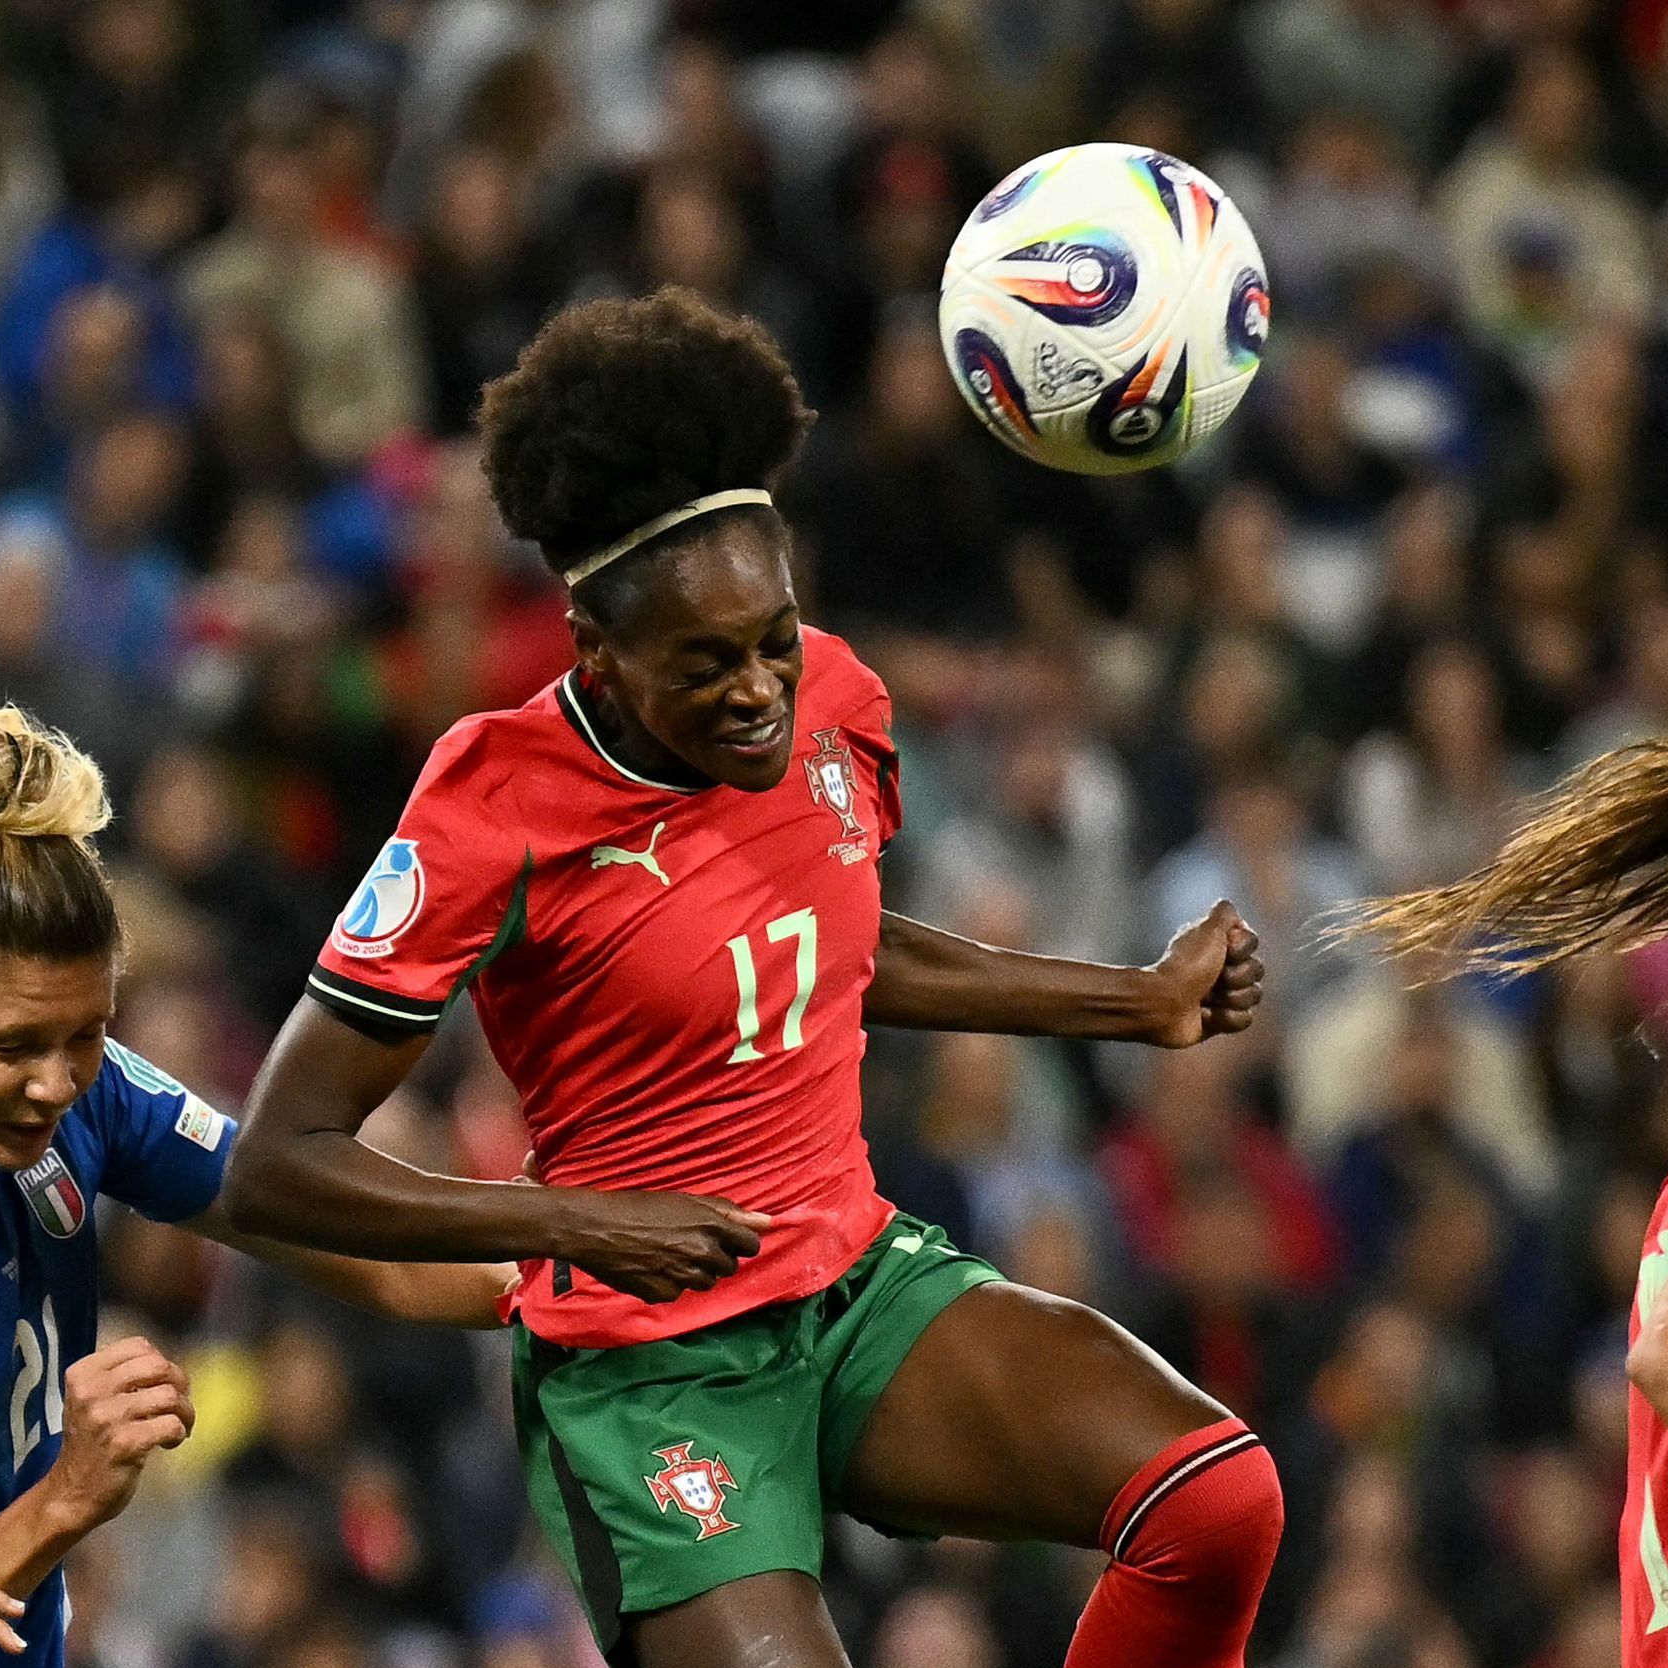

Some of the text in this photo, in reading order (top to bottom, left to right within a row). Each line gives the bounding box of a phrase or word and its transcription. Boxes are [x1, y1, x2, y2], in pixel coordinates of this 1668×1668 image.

[362, 942, 388, 954] 2025
[725, 905, 818, 1065] 17
[19, 1155, 61, 1191] ITALIA
[10, 1294, 64, 1475] 21
